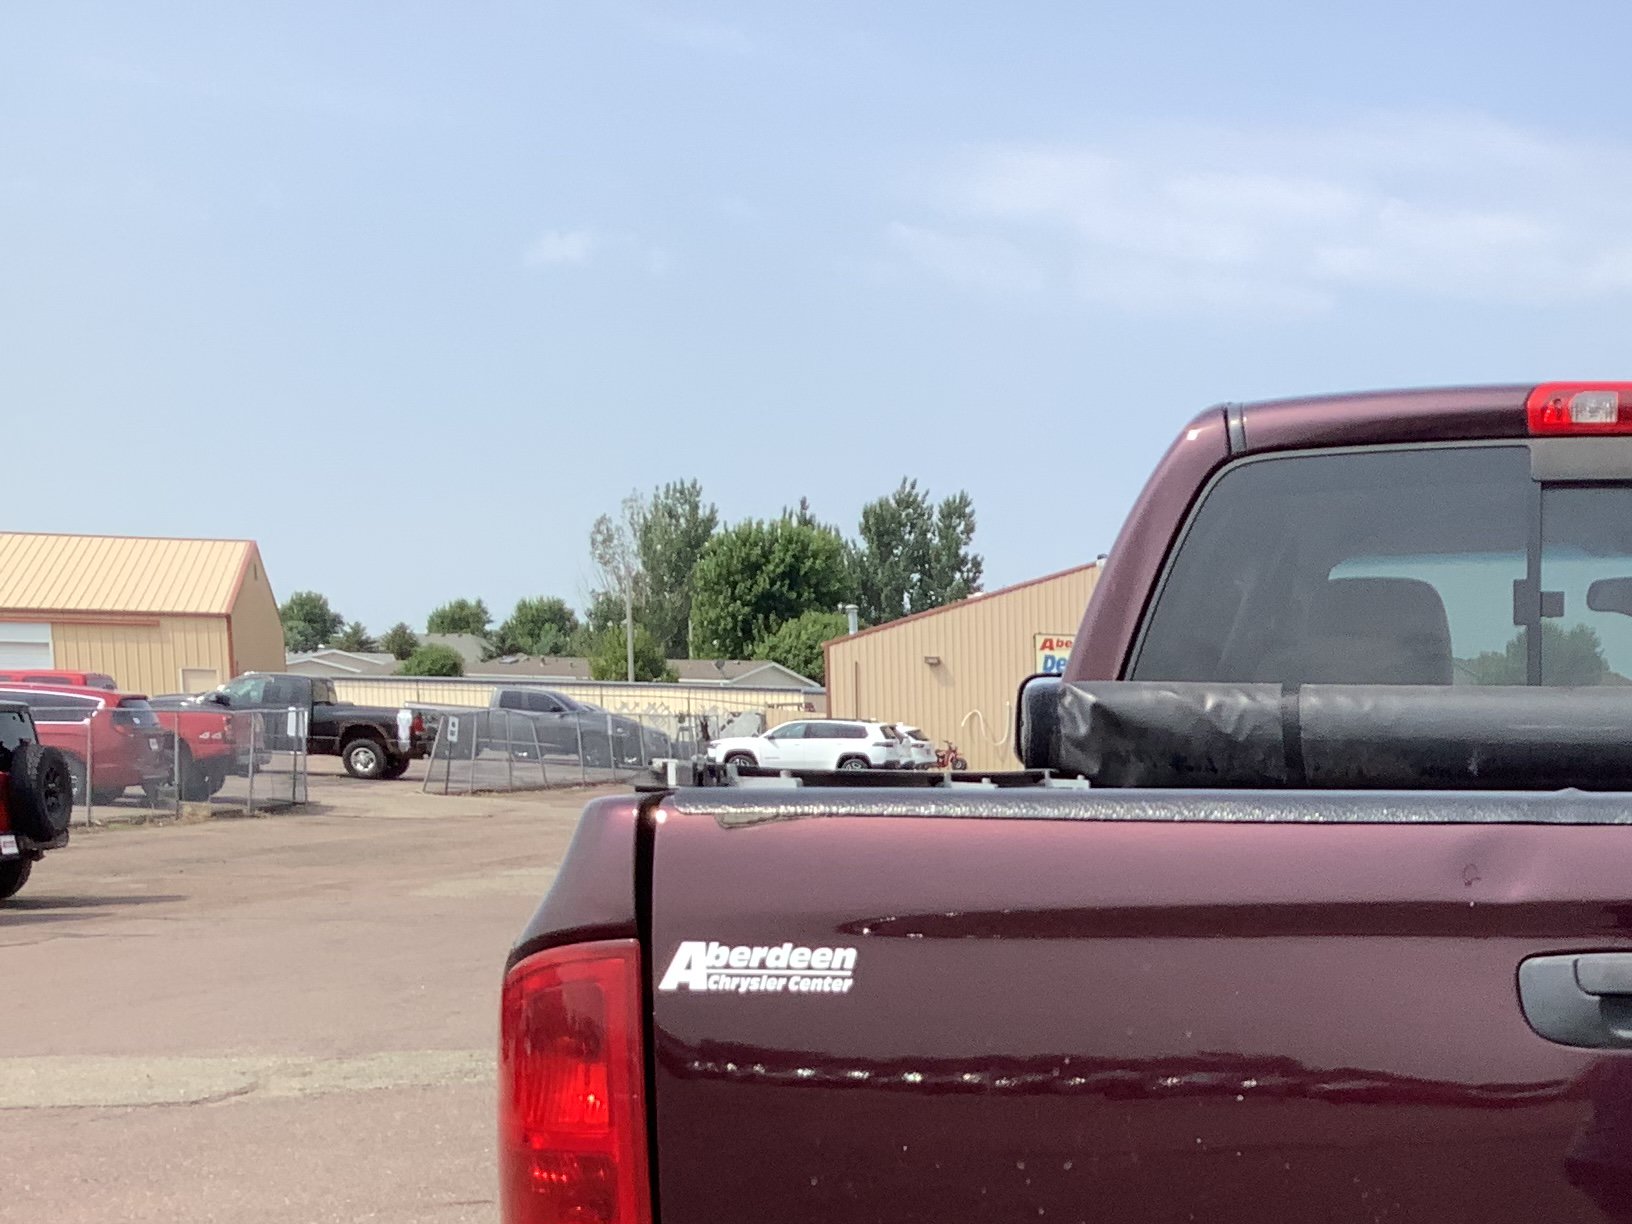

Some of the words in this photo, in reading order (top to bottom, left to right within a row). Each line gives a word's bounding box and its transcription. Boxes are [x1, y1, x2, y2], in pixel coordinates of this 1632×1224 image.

[658, 941, 858, 990] Aberdeen
[708, 974, 786, 993] Chrysler
[789, 976, 853, 993] Center
